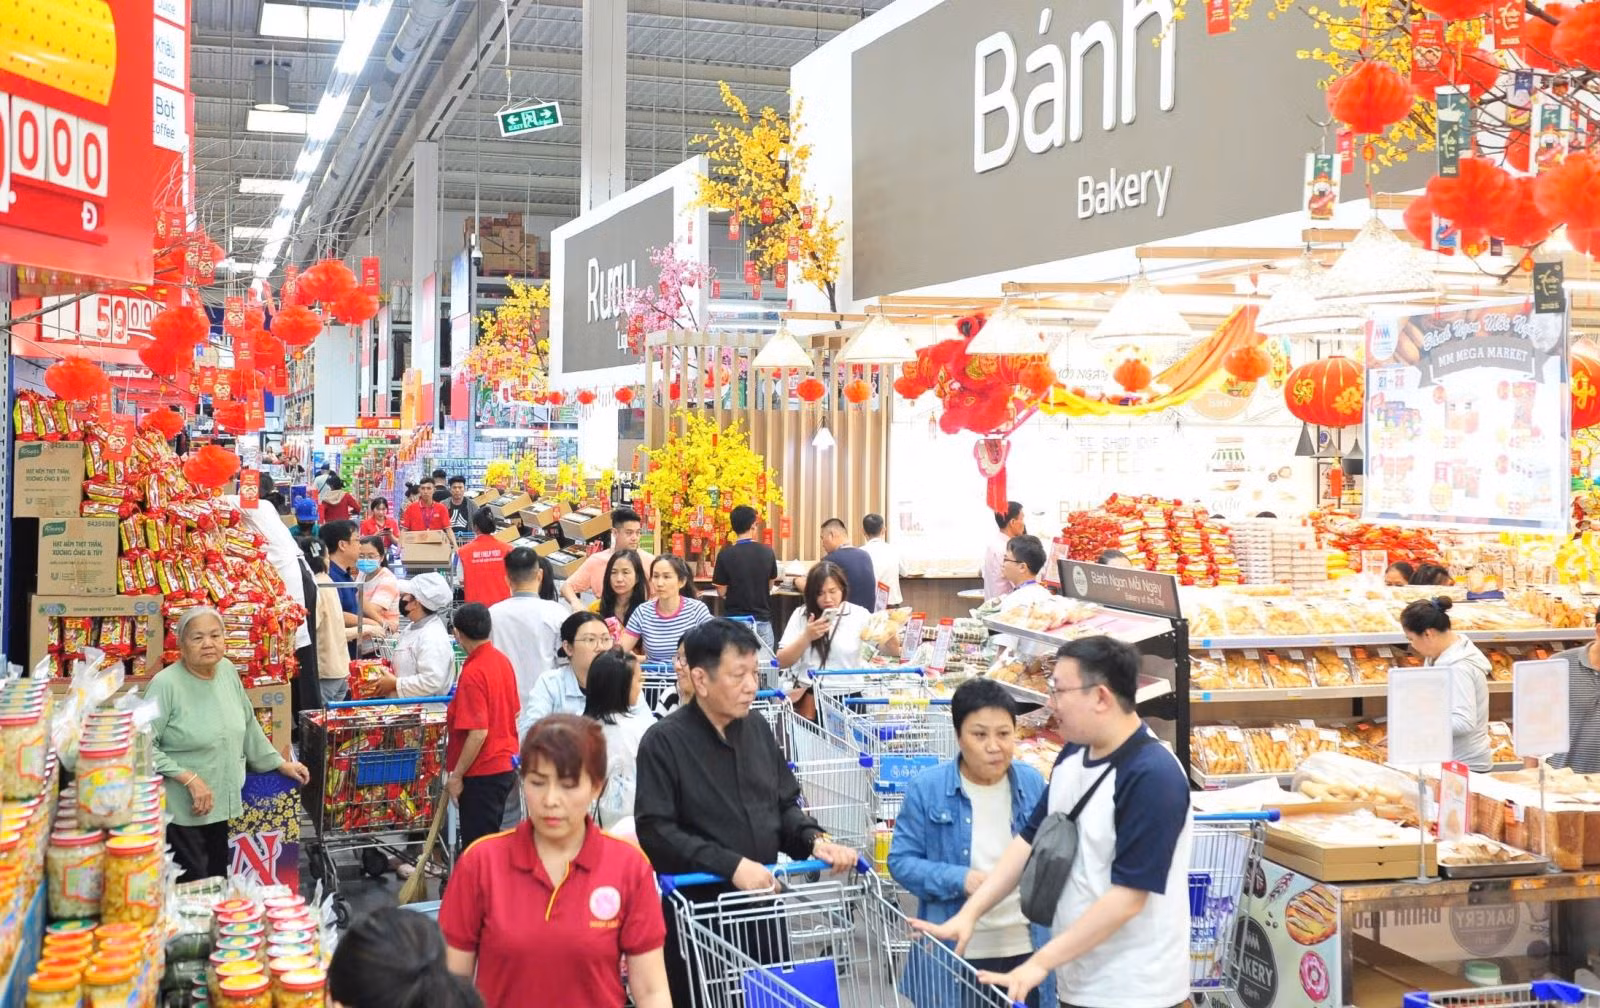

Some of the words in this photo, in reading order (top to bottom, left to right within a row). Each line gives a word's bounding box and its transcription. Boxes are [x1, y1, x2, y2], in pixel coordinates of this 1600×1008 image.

[973, 0, 1176, 173] Bánh
[155, 96, 176, 121] Bột
[152, 121, 176, 140] offee
[1078, 166, 1172, 219] Bakery
[1438, 352, 1454, 368] MM
[1456, 347, 1485, 362] MEGA
[1487, 346, 1528, 362] MARKET
[1090, 571, 1109, 585] Bánh
[1109, 574, 1128, 591] Ngon
